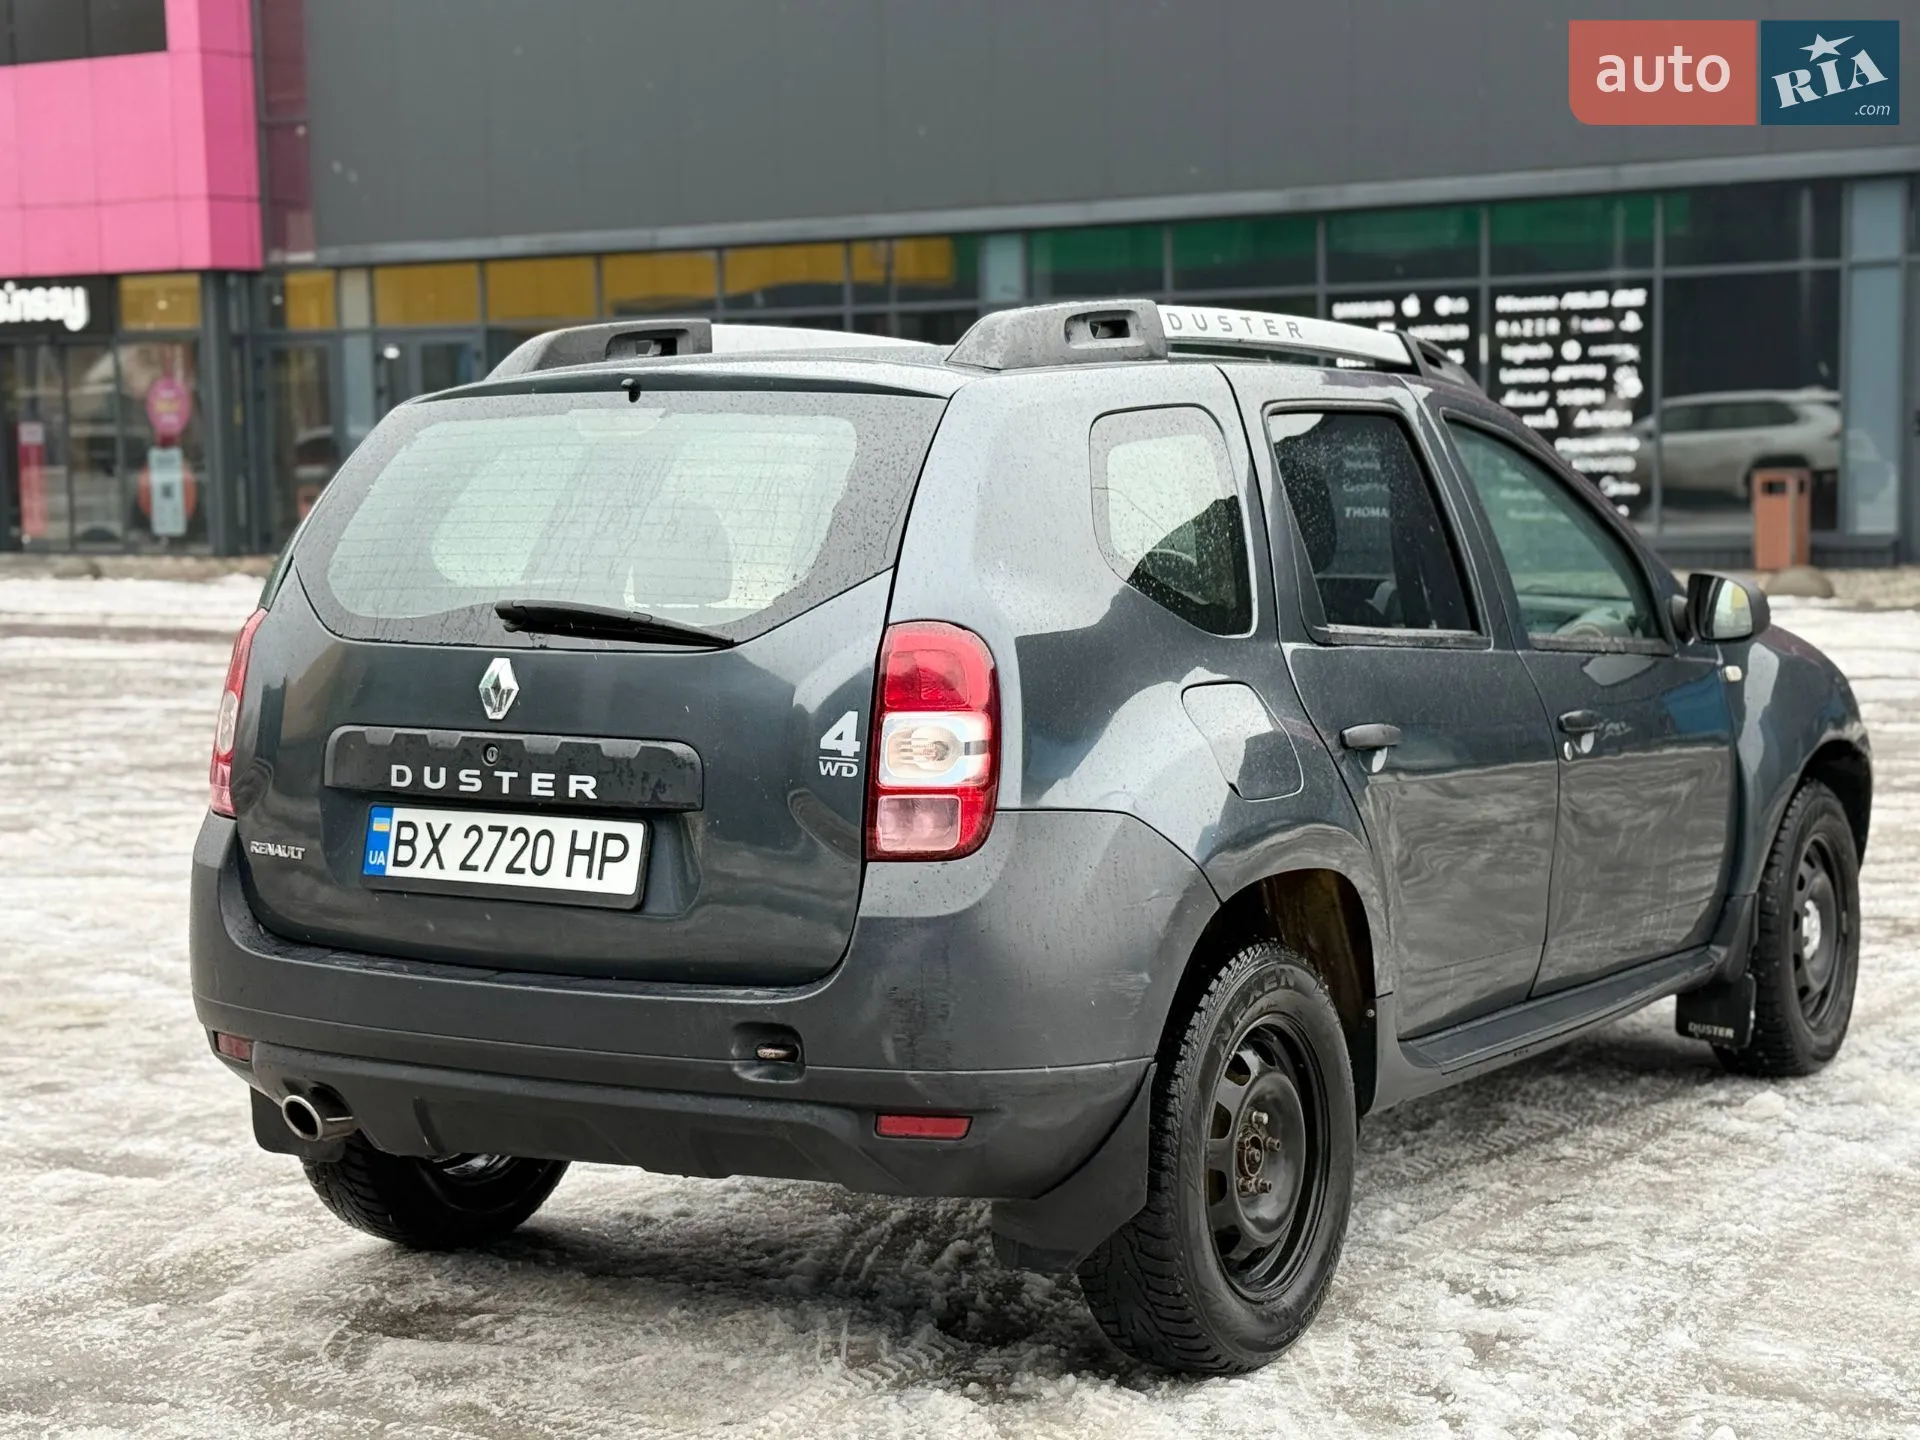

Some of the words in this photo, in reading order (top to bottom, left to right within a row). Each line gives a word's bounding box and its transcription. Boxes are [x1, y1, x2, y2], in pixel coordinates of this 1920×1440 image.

[1166, 312, 1303, 339] DUSTER
[819, 710, 861, 757] 4
[818, 760, 859, 778] WD
[390, 764, 599, 800] DUSTER
[250, 841, 305, 861] RENAULT
[368, 850, 386, 866] UA
[392, 820, 452, 870] BX
[459, 824, 555, 876] 2720
[565, 829, 630, 881] HP
[1688, 1022, 1735, 1039] DUSTER
